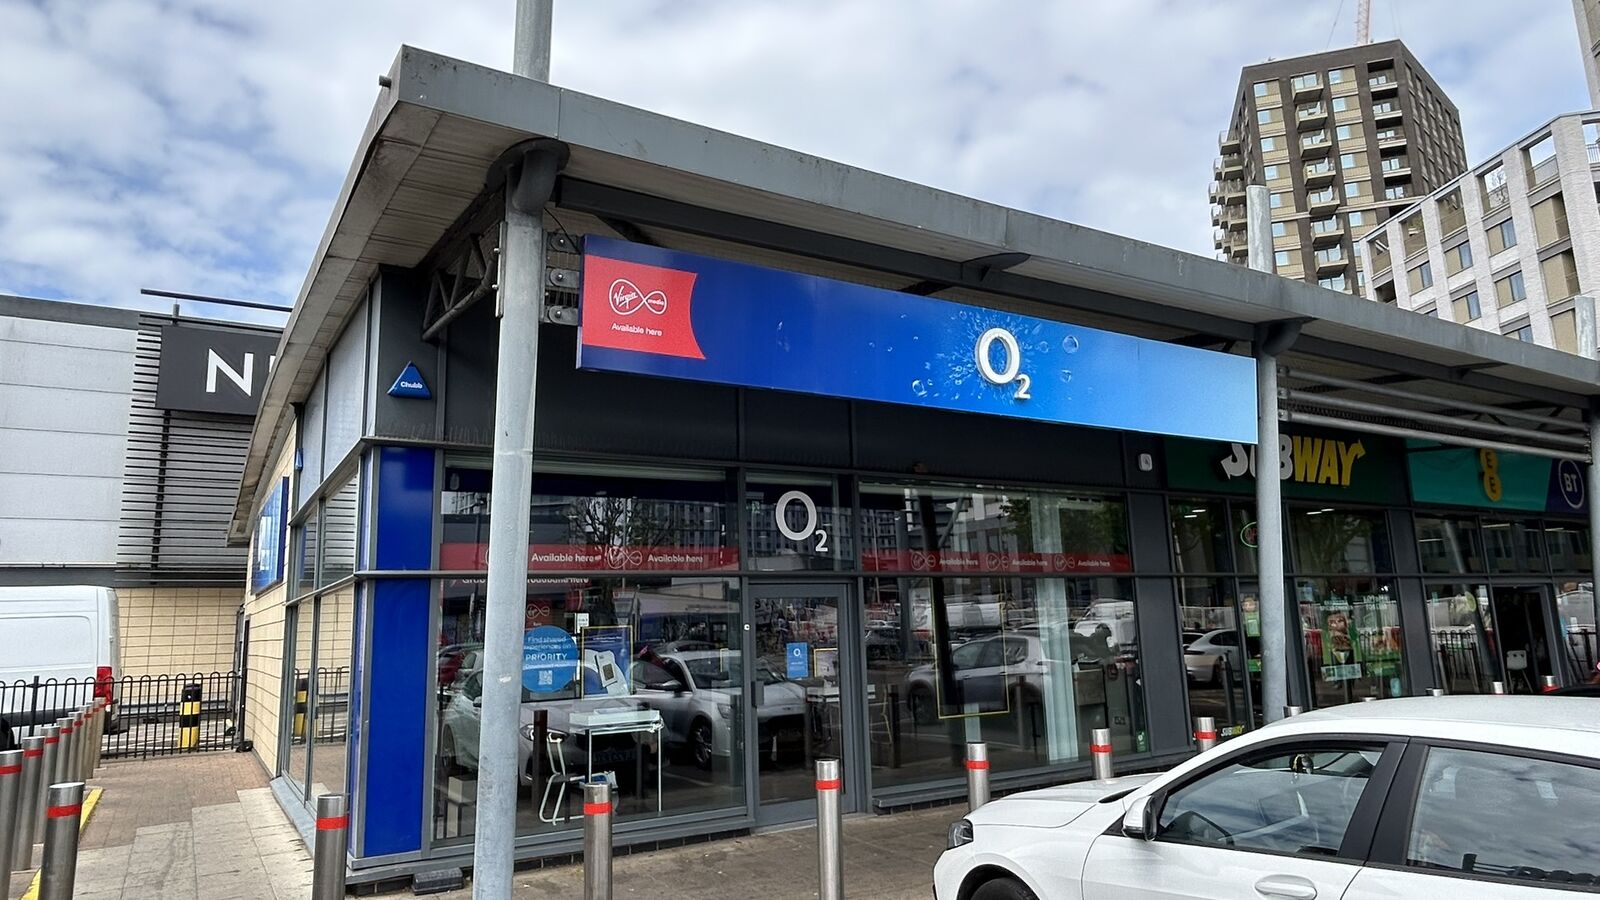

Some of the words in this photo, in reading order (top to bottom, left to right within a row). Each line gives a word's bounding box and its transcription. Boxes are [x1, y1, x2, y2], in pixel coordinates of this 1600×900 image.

[613, 286, 638, 309] Virgin
[611, 322, 645, 334] Available
[645, 327, 663, 336] here
[975, 328, 1031, 399] O2
[206, 349, 276, 396] N
[400, 381, 423, 389] Chubb
[1563, 473, 1578, 492] BT
[775, 490, 829, 552] O2
[531, 552, 573, 562] Available
[574, 553, 595, 562] here
[647, 554, 684, 563] Available
[685, 554, 704, 563] here
[939, 558, 965, 566] Available
[1012, 558, 1036, 567] Available
[1077, 559, 1099, 567] Available
[525, 653, 568, 661] PRIORITY
